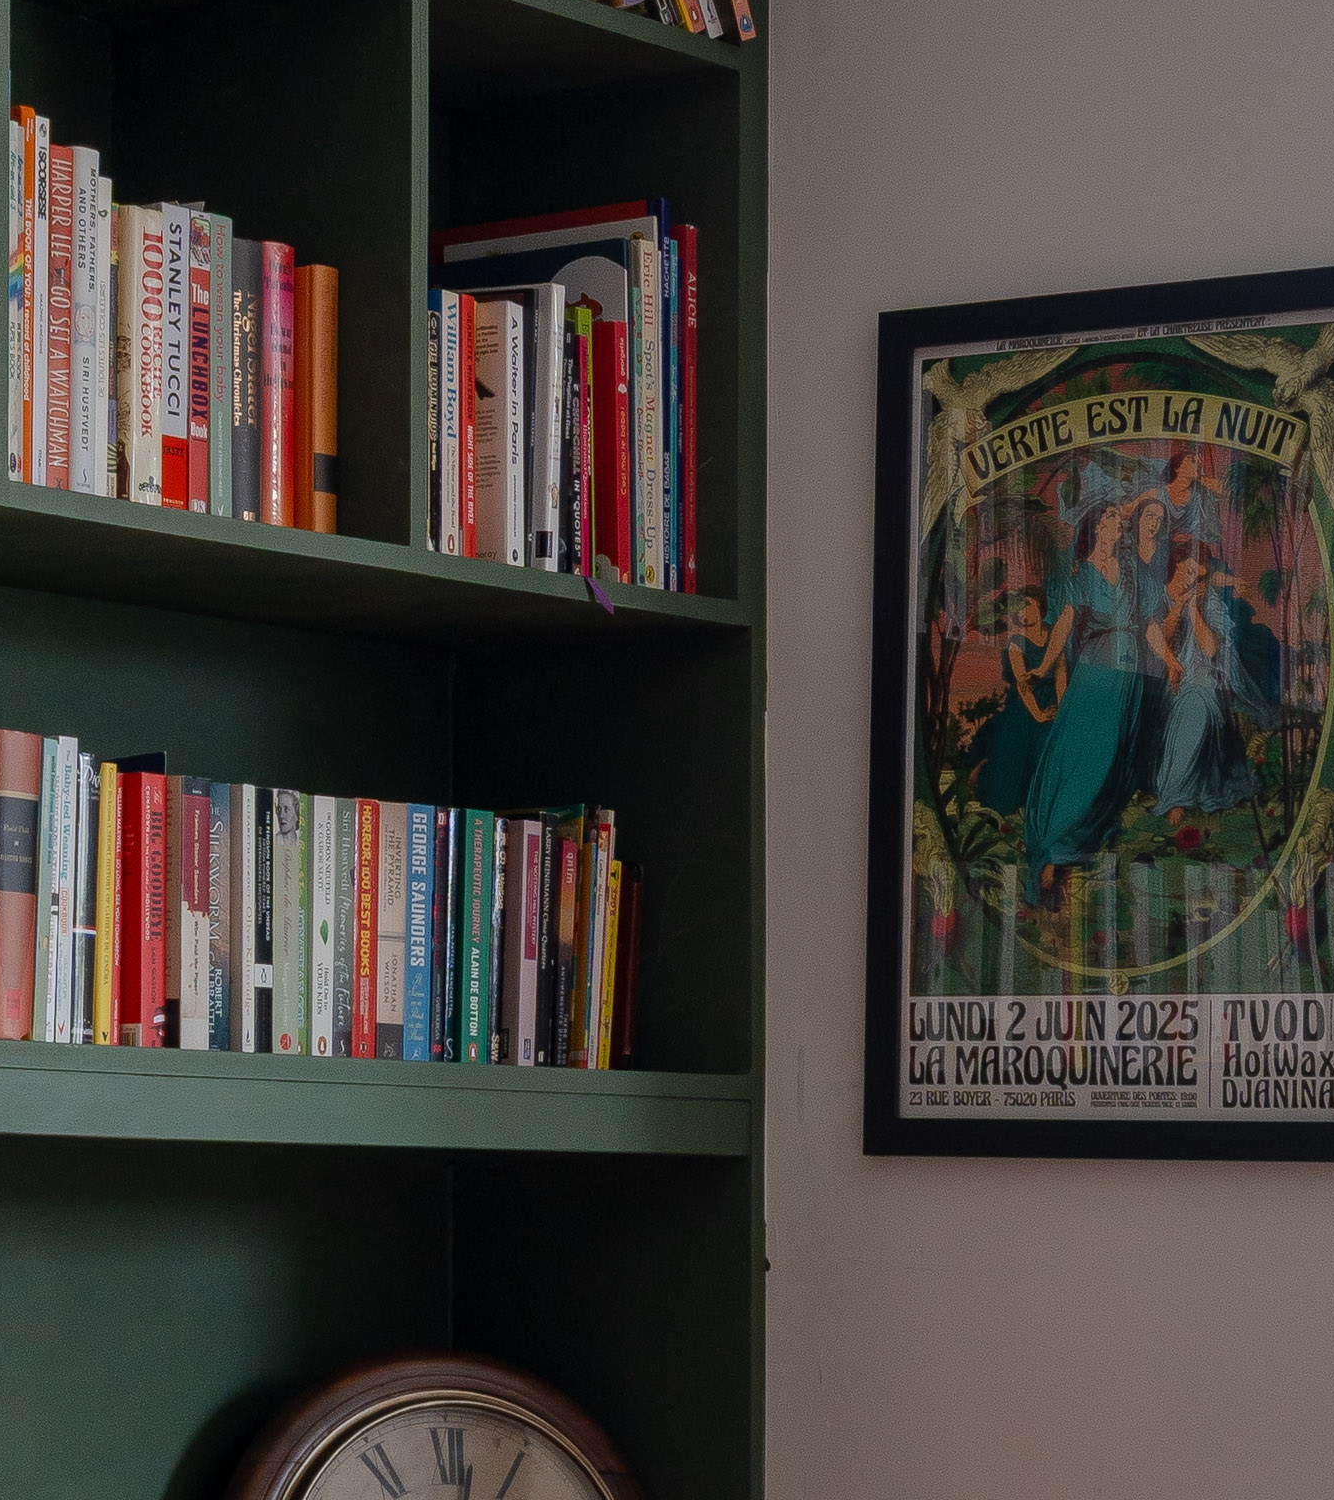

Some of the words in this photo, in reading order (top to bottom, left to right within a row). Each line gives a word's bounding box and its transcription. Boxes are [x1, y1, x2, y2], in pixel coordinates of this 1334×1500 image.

[51, 158, 72, 227] HARPER
[78, 188, 87, 214] AND
[51, 233, 72, 261] LEE
[78, 219, 87, 269] OTHERS
[169, 222, 182, 332] STANLEY
[643, 251, 653, 288] Eric
[50, 285, 71, 310] GO
[191, 283, 209, 306] The
[643, 294, 654, 326] Hill
[687, 271, 697, 329] ALICE
[49, 315, 71, 345] SET
[446, 303, 458, 379] William
[1150, 325, 1160, 335] LA
[1162, 320, 1214, 335] CHARTREUSE
[49, 349, 69, 360] A
[82, 357, 90, 382] SIRI
[167, 340, 181, 417] TUCCI
[191, 305, 210, 420] LUNCHBOX
[644, 339, 655, 392] Spot's
[141, 322, 153, 438] COOKBOOK
[48, 368, 70, 469] WATCHMAN
[82, 387, 90, 452] HUSTVEDT
[190, 421, 208, 440] Book
[445, 387, 458, 440] Boyd
[645, 396, 656, 463] Magnet
[968, 408, 1073, 481] VERTE
[1087, 395, 1149, 428] EST
[1162, 397, 1204, 434] LA
[1214, 401, 1297, 457] NUIT
[646, 468, 657, 549] Dress-Up
[361, 805, 372, 866] HORROR:
[411, 813, 427, 874] GEORGE
[209, 821, 223, 940] SILKWORM
[361, 867, 372, 890] 100
[394, 837, 402, 899] INVERTING
[360, 892, 371, 929] BEST
[410, 879, 427, 967] SAUNDERS
[360, 932, 371, 977] BOOKS
[470, 947, 480, 979] ALAIN
[214, 968, 223, 1017] ROBERT
[470, 981, 480, 994] DE
[469, 996, 480, 1037] BOTTON
[909, 1000, 996, 1041] LUNDI
[1006, 1001, 1026, 1041] 2
[1036, 1000, 1105, 1041] JUIN
[1117, 999, 1198, 1041] 2025
[909, 1045, 945, 1085] LA
[955, 1045, 1197, 1090] MAROQUINERIE
[909, 1091, 923, 1106] 23
[926, 1091, 951, 1106] RUE
[953, 1091, 991, 1106] BOYER
[1003, 1091, 1037, 1106] 75020
[1041, 1090, 1076, 1106] PARIS
